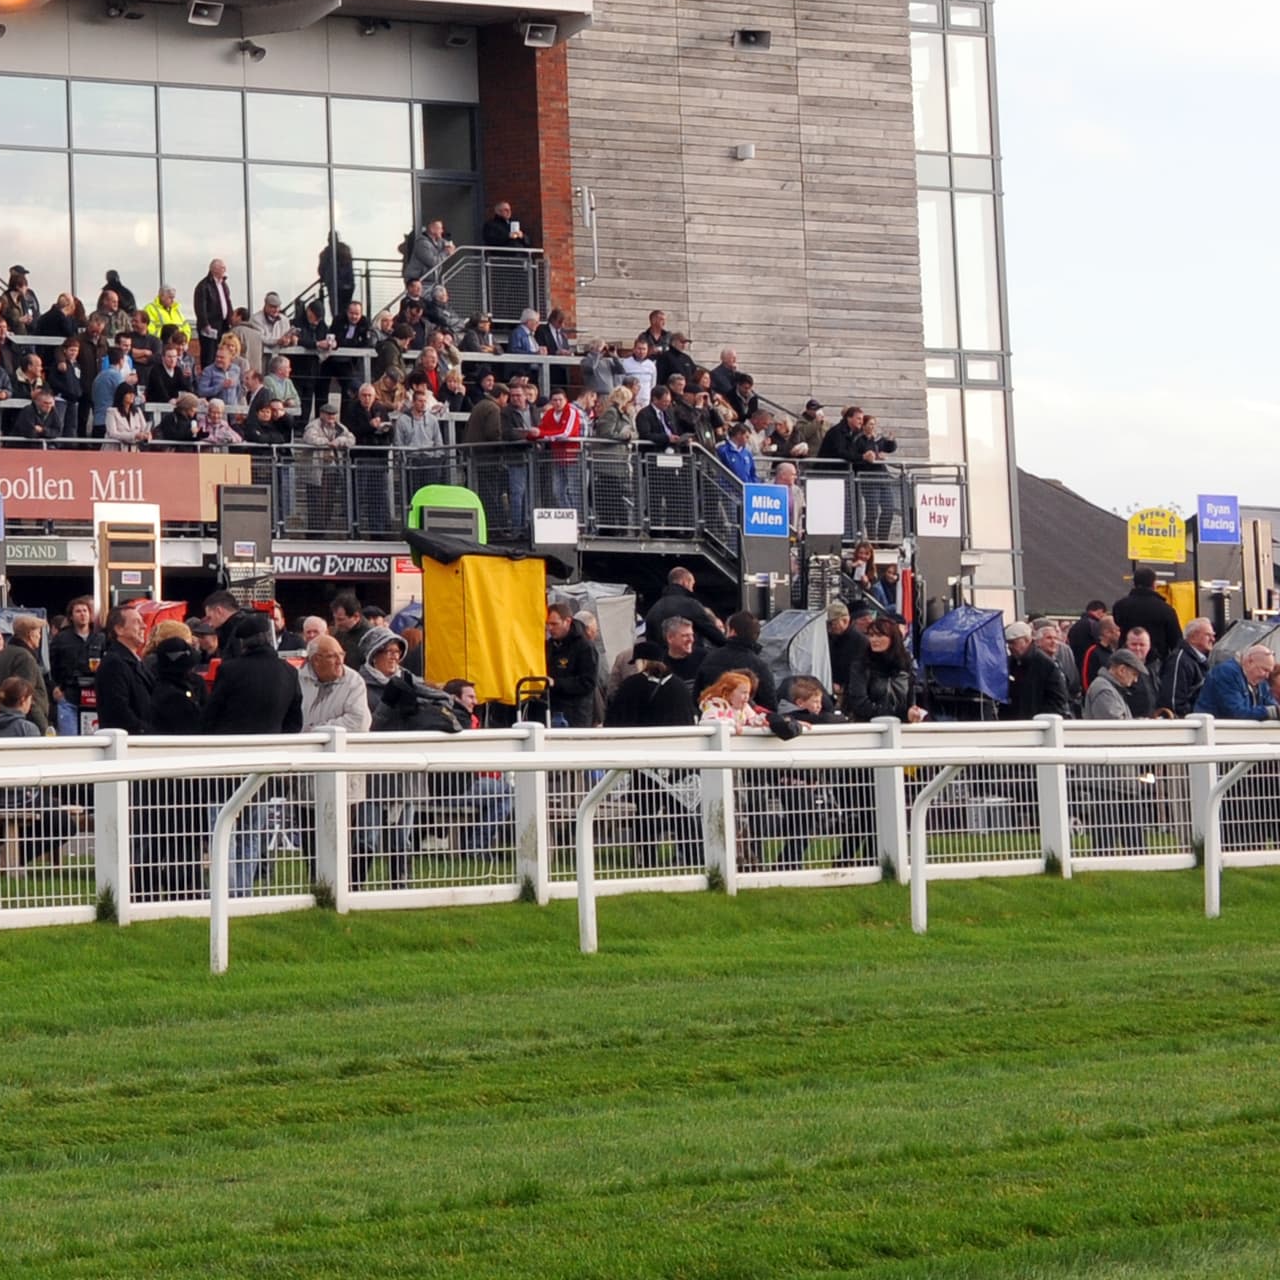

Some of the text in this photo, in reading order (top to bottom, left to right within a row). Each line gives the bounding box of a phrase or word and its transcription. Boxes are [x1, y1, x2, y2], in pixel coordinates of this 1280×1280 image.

[90, 468, 145, 501] Mill
[752, 495, 781, 510] Mike
[920, 493, 957, 507] Arthur
[537, 511, 575, 520] JACK ADAMS
[1206, 503, 1231, 518] Ryan
[751, 512, 783, 526] Allen
[929, 512, 949, 528] Hay
[1202, 518, 1236, 533] Racing
[1138, 523, 1177, 537] Hazell
[6, 545, 57, 559] DSTAND
[274, 555, 321, 574] RLING
[323, 554, 389, 576] EXPRESS
